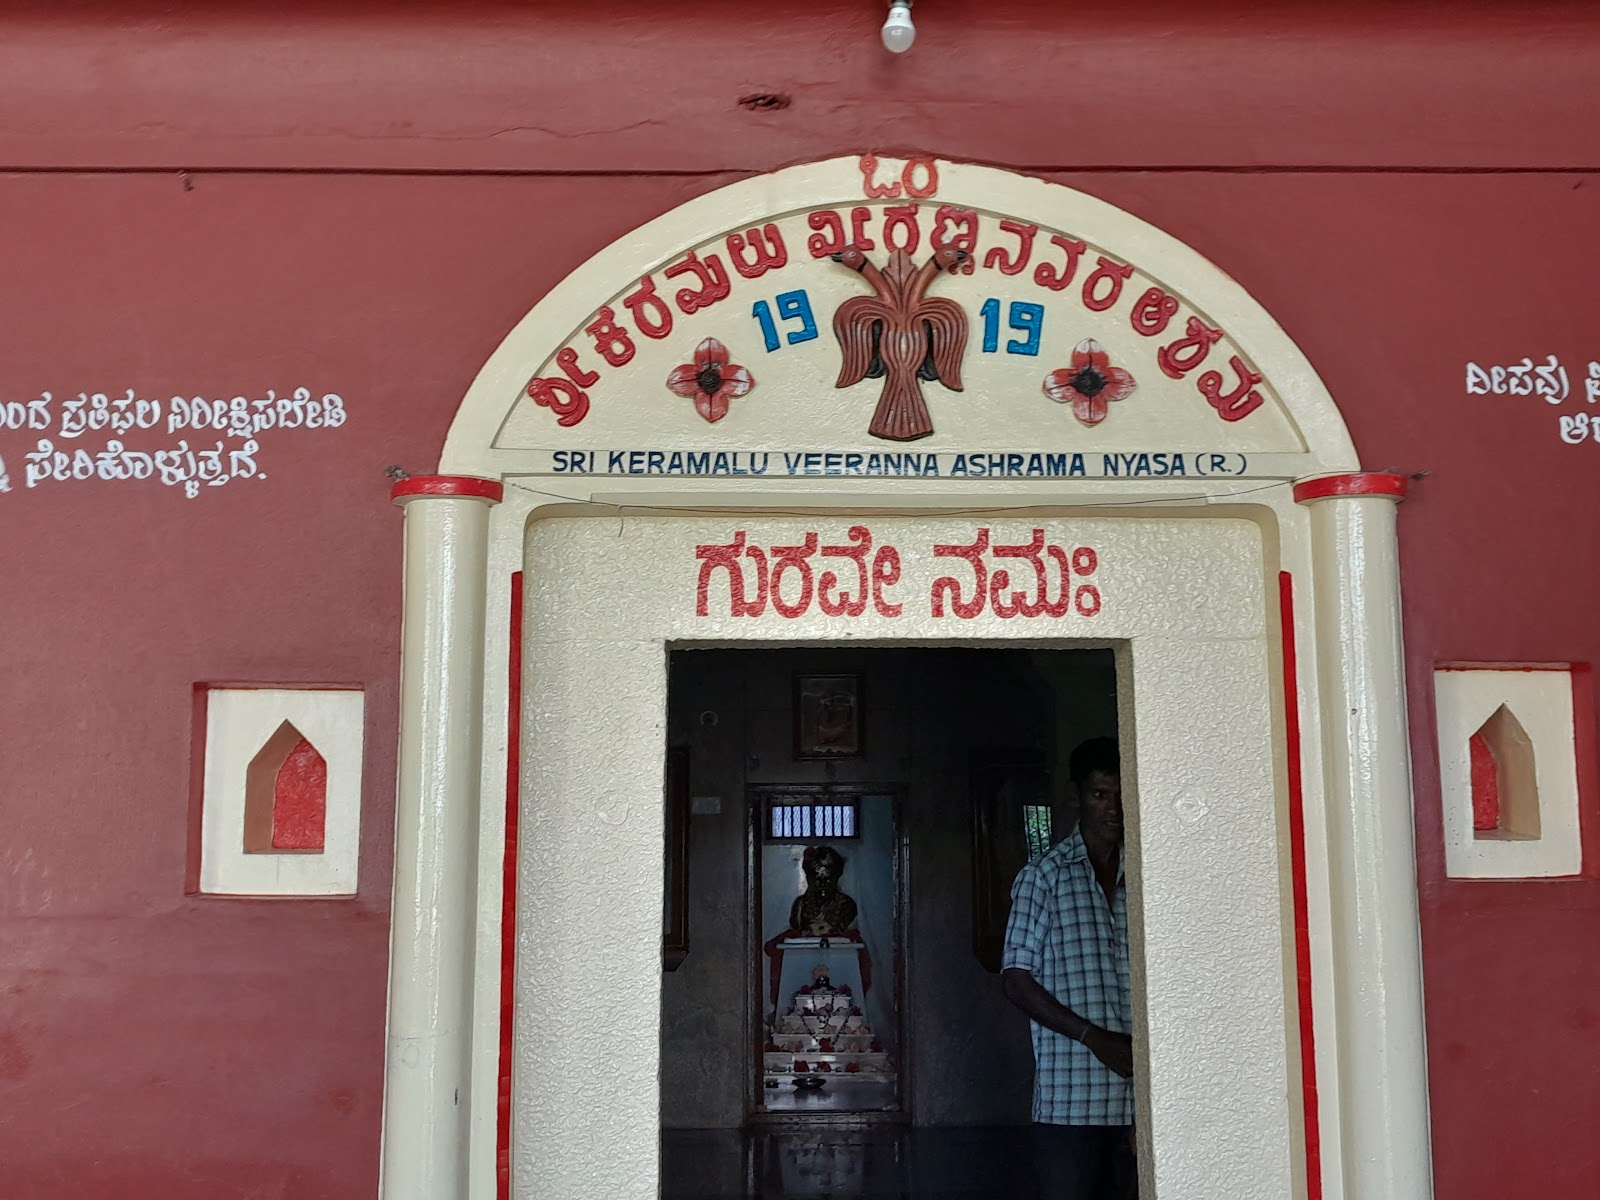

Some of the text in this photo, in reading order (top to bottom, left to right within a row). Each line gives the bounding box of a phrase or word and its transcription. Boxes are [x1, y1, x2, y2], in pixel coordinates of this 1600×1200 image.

[752, 288, 1045, 357] 19 19
[552, 451, 1247, 477] SRI KERAMALU VEERANNA ASHRAMA NYASA (R.)
[695, 525, 903, 619] ಗುರವೇ
